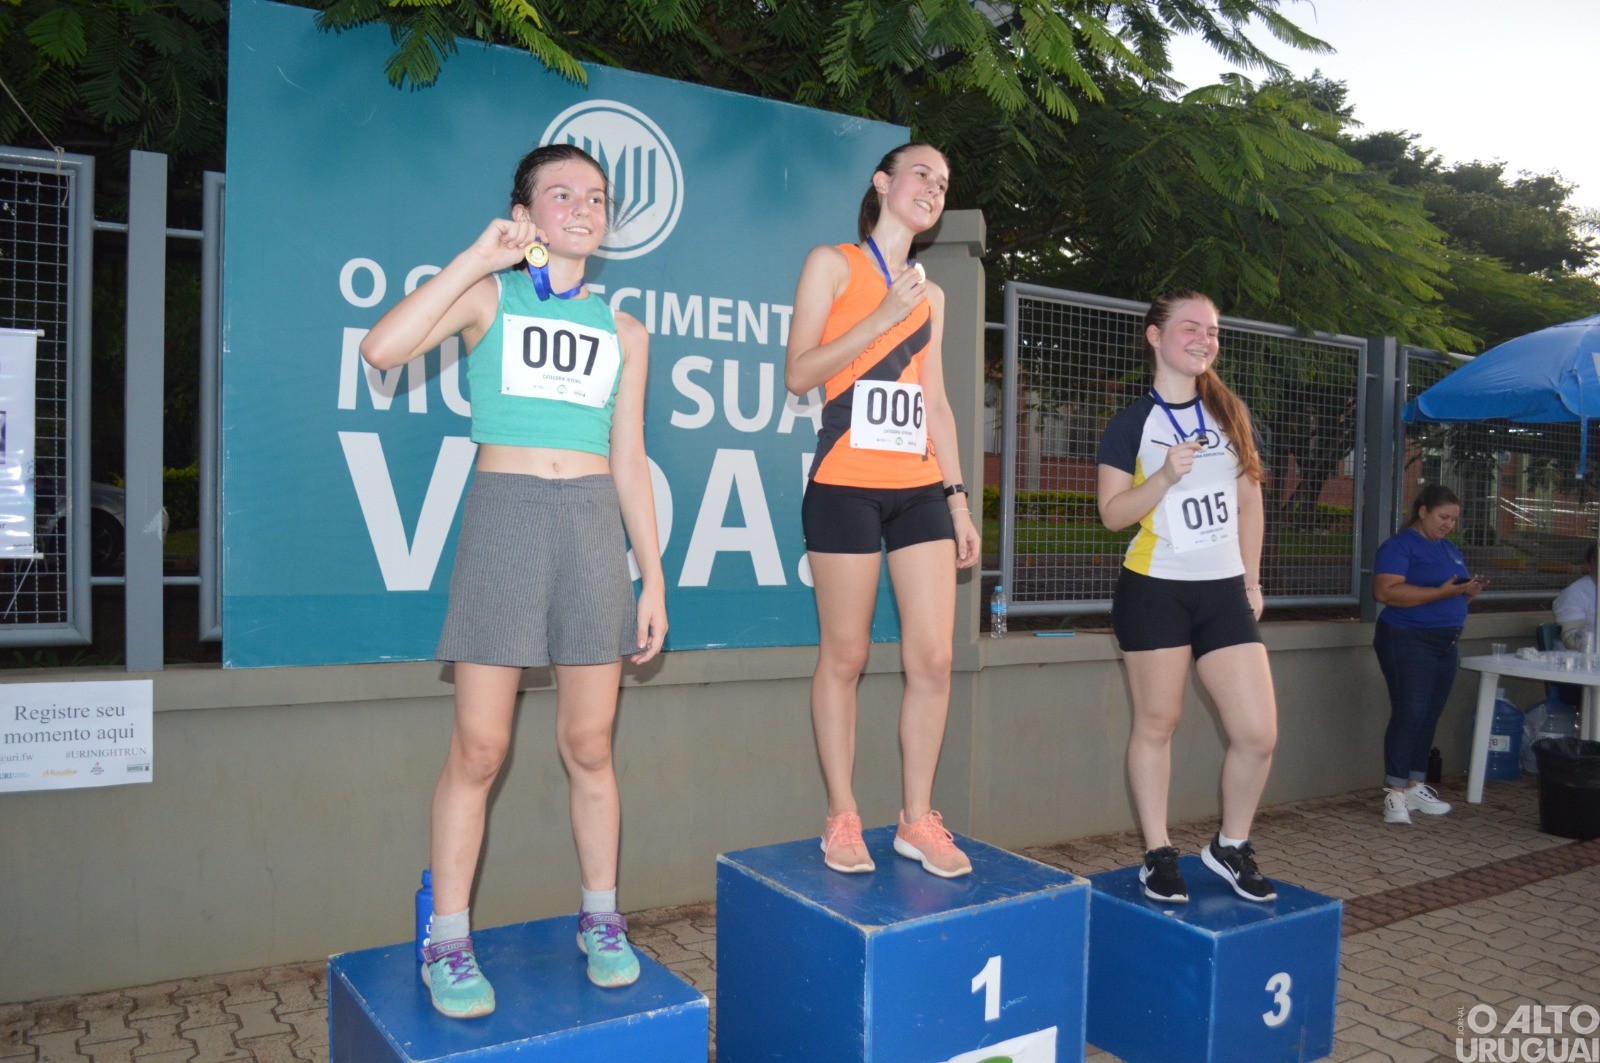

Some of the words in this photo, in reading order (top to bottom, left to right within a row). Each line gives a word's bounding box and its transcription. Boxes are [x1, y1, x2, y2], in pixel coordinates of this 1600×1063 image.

[339, 257, 387, 308] O
[522, 325, 600, 376] 007
[670, 355, 823, 435] SUA
[866, 387, 923, 429] 006
[1181, 491, 1229, 530] 015
[4, 728, 91, 744] momento
[97, 723, 134, 744] aqui
[14, 704, 90, 724] Registre
[96, 705, 126, 718] seu
[65, 747, 147, 759] #URINIGHTRUN
[436, 941, 467, 953] Kappa
[971, 955, 1001, 1022] 1
[1262, 972, 1292, 1028] 3
